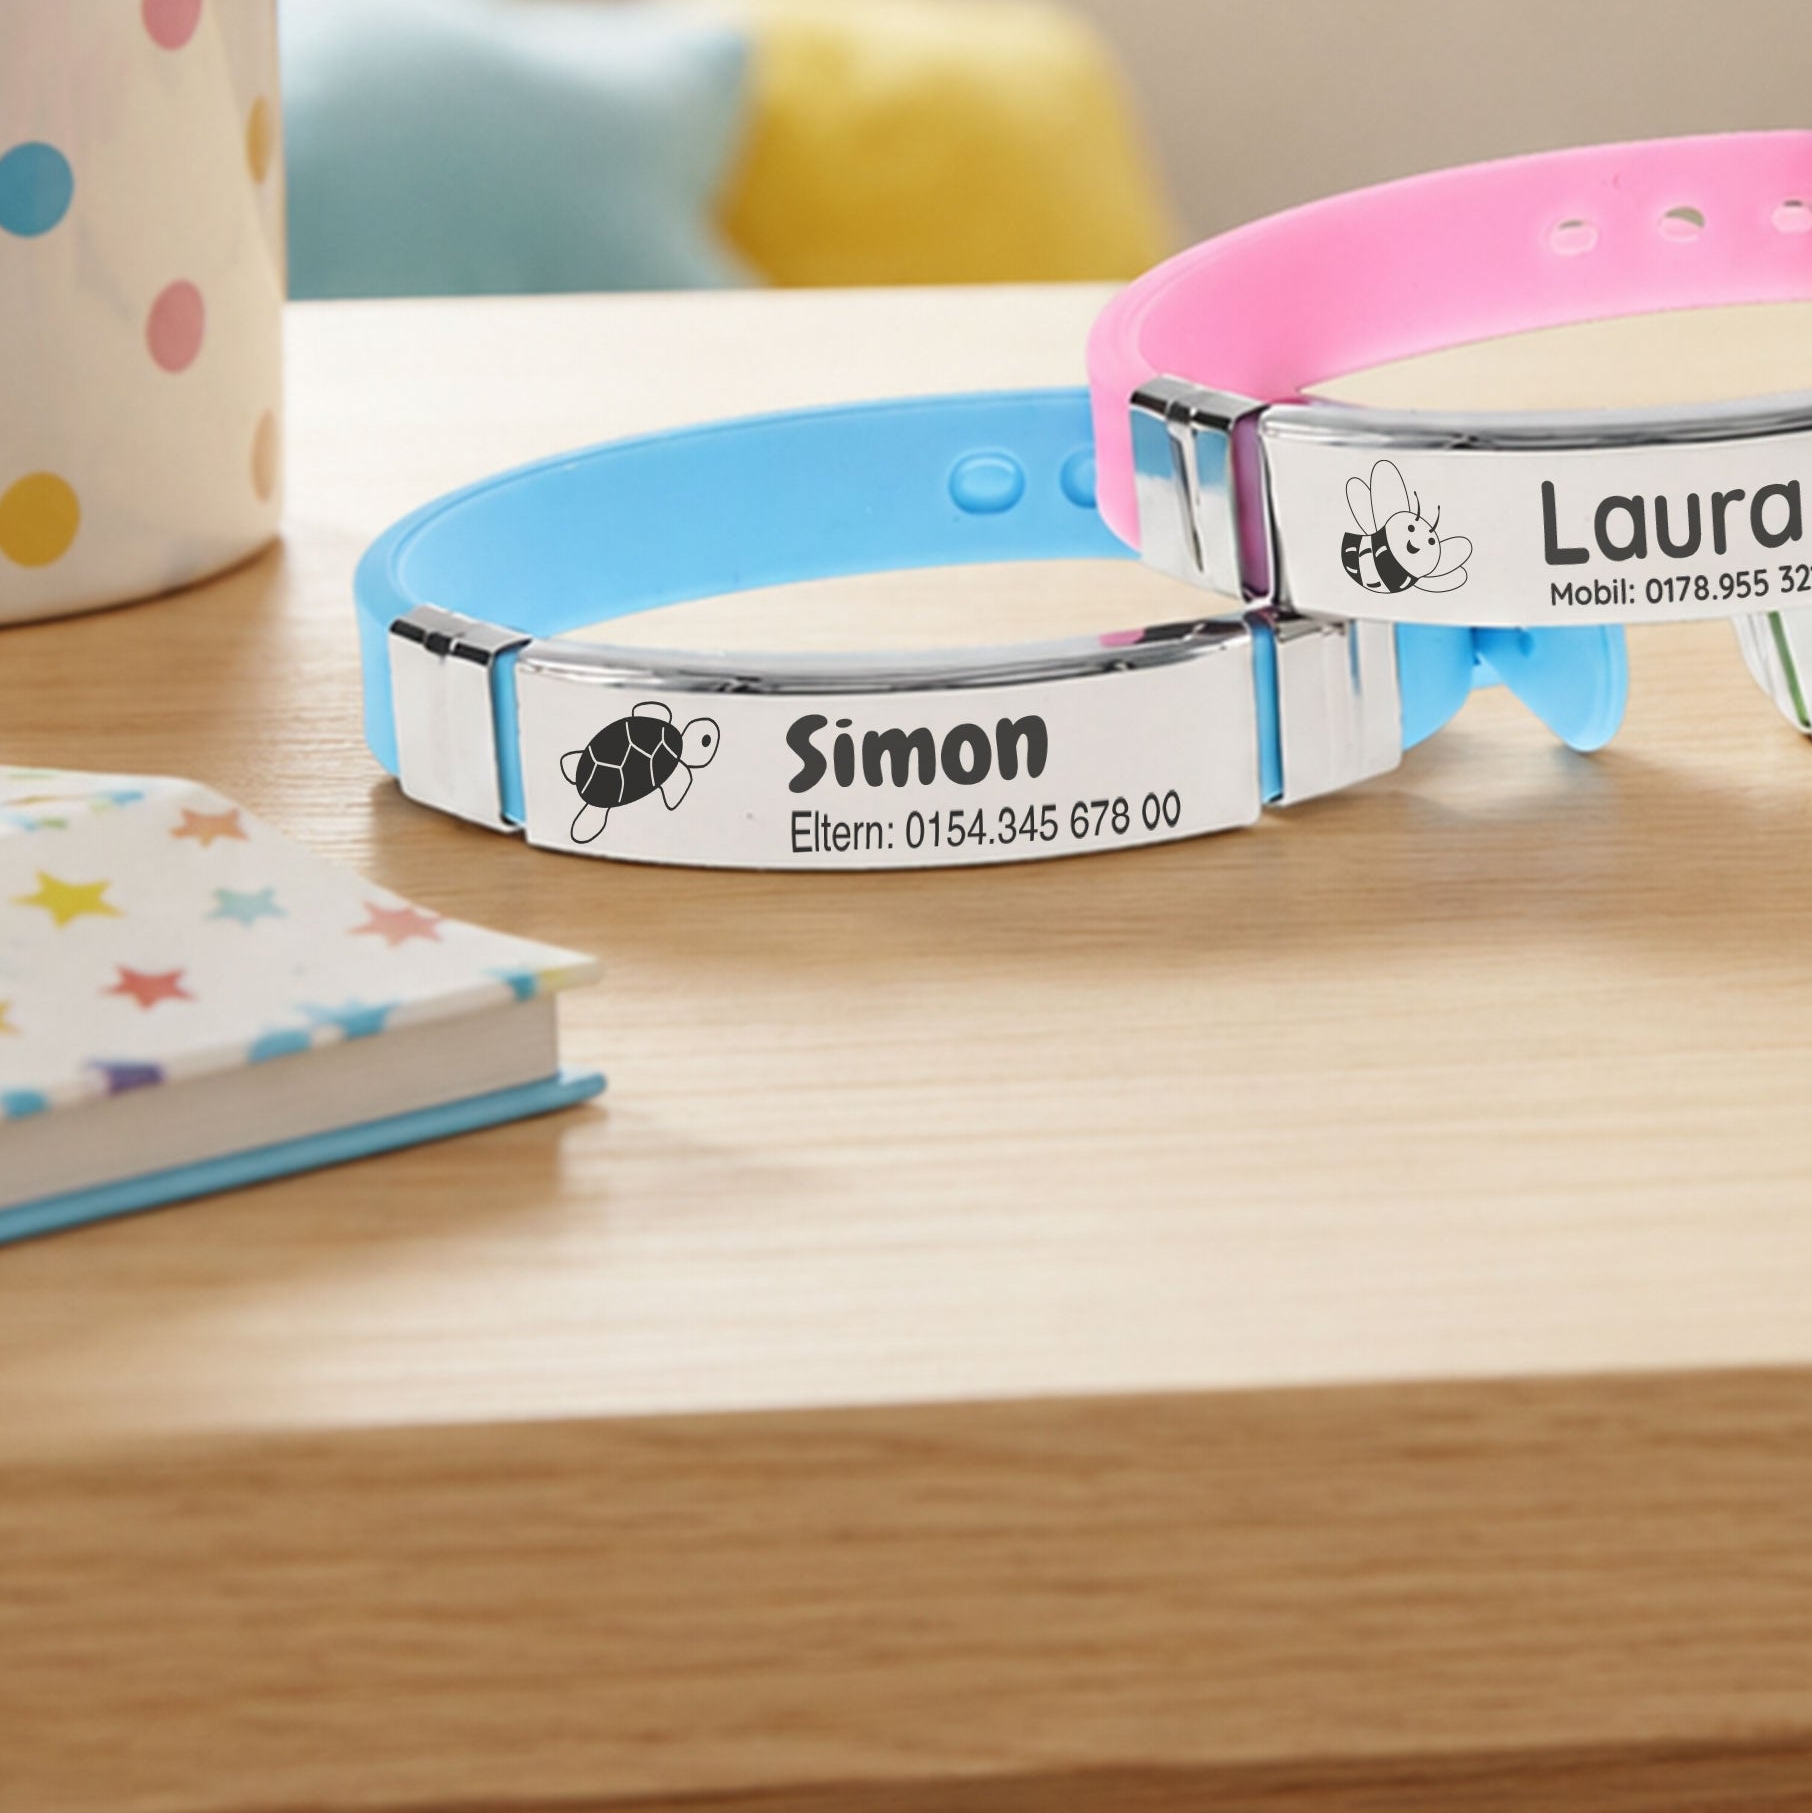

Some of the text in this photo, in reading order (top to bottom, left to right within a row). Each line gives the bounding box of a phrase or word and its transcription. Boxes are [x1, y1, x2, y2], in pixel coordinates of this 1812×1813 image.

[1541, 479, 1803, 566] Laura
[1550, 577, 1635, 606] Mobil:
[1645, 568, 1770, 605] 0178.955
[785, 713, 1049, 794] Simon
[791, 789, 1181, 854] Eltern: 0154.345 678 00
